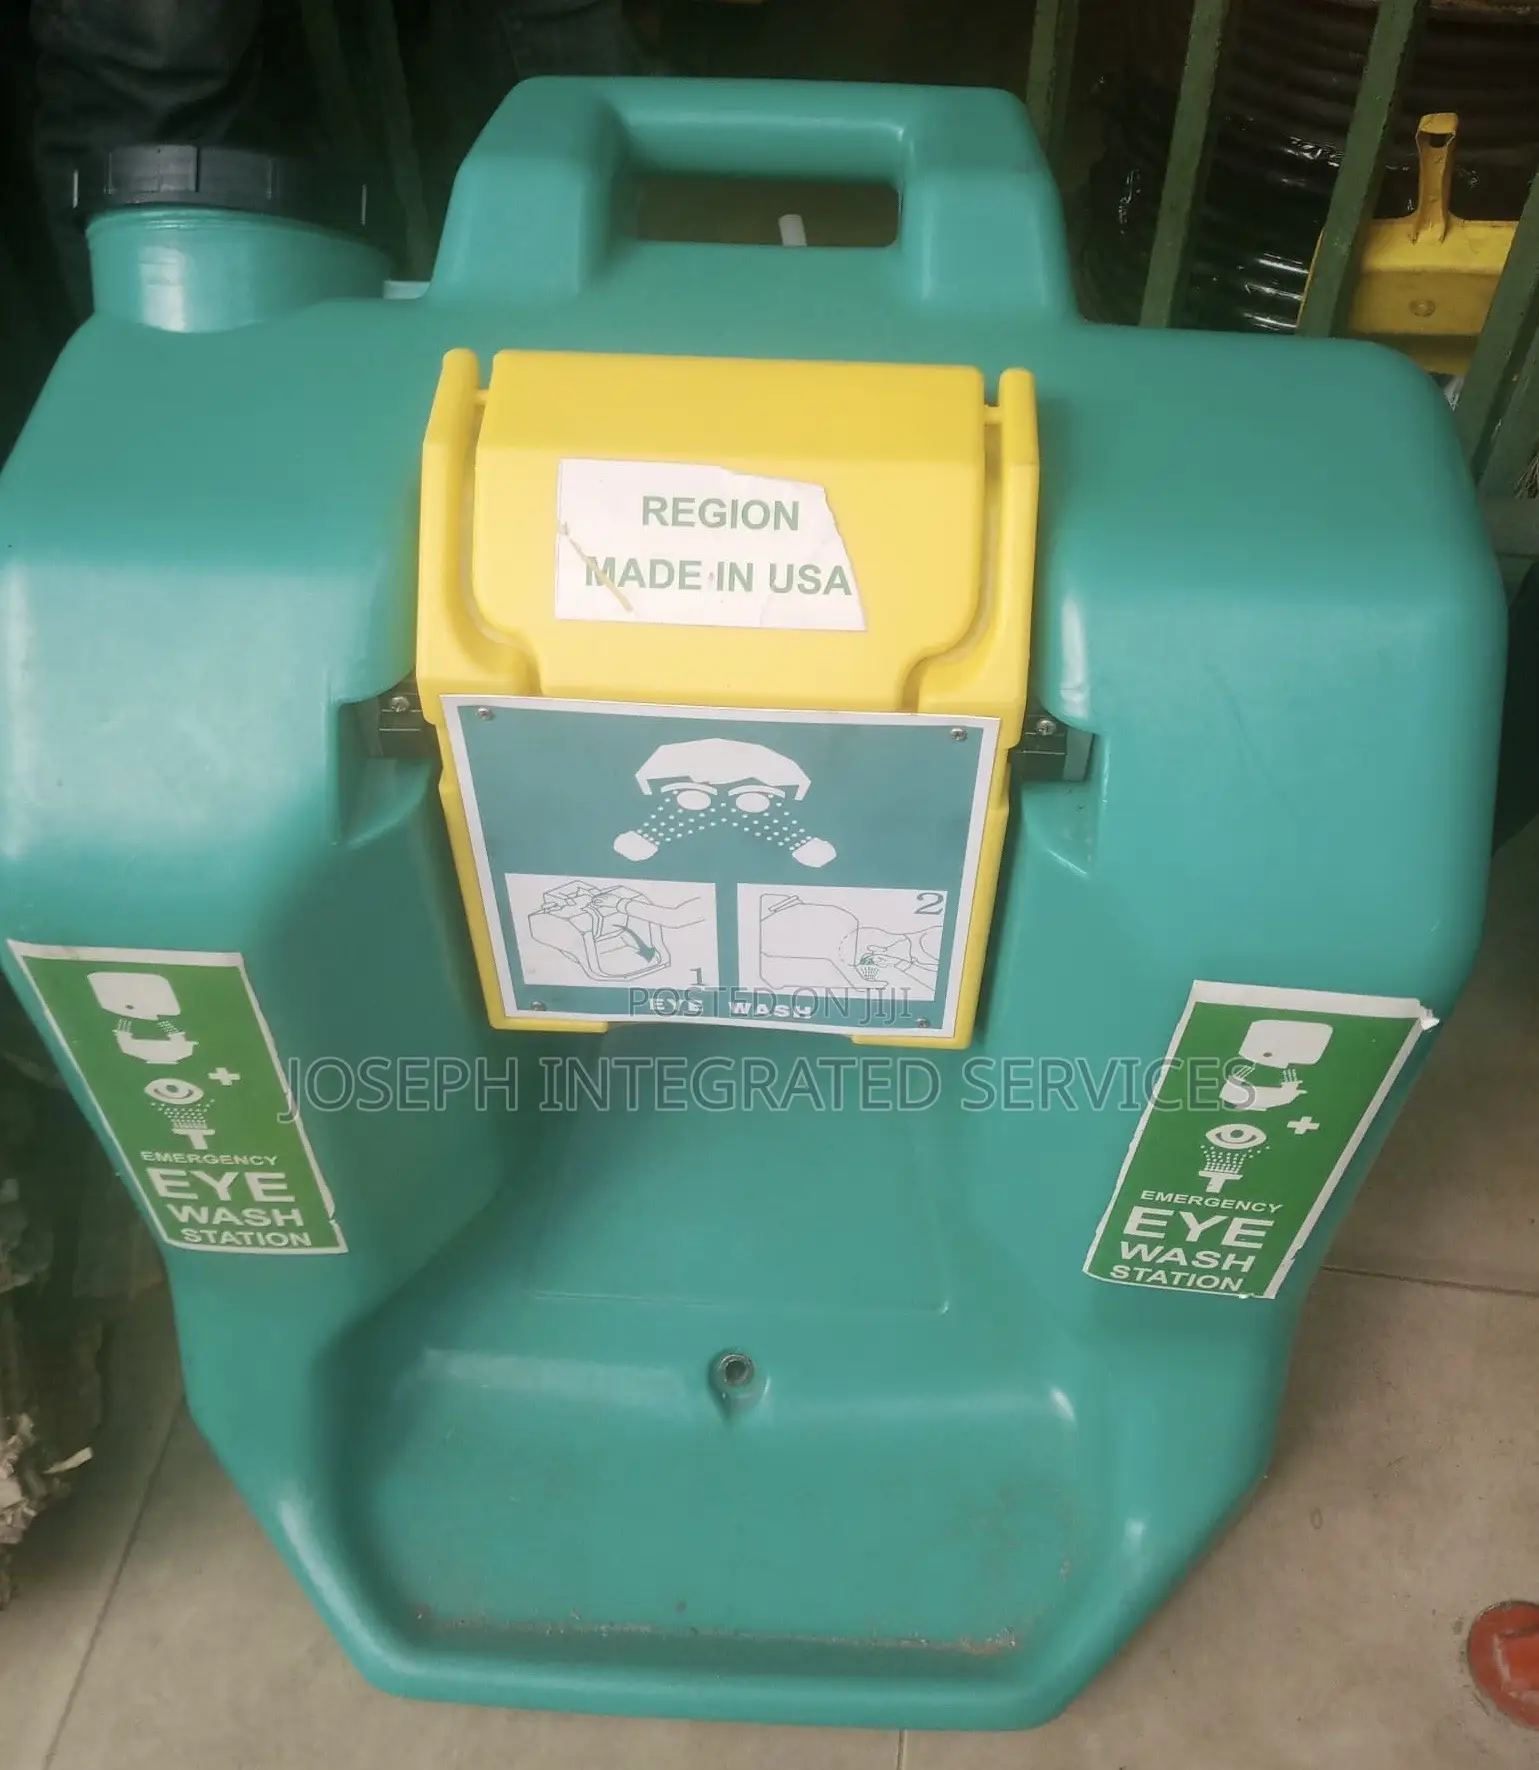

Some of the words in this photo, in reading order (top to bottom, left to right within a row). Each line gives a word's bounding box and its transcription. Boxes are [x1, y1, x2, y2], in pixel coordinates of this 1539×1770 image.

[641, 495, 800, 532] REGION
[585, 556, 702, 591] MADE
[716, 561, 754, 593] IN
[769, 562, 853, 596] USA
[913, 892, 944, 915] 2
[689, 967, 709, 986] 1
[649, 997, 704, 1014] EYE
[727, 1000, 812, 1020] WASH
[140, 1150, 279, 1166] EMERGENCY
[146, 1167, 296, 1203] EYE
[1139, 1189, 1284, 1214] EMERGENCY
[166, 1203, 305, 1228] WASH
[1122, 1204, 1276, 1250] EYE
[180, 1227, 312, 1248] STATION
[1119, 1241, 1256, 1274] WASH
[1109, 1264, 1244, 1292] STATION
